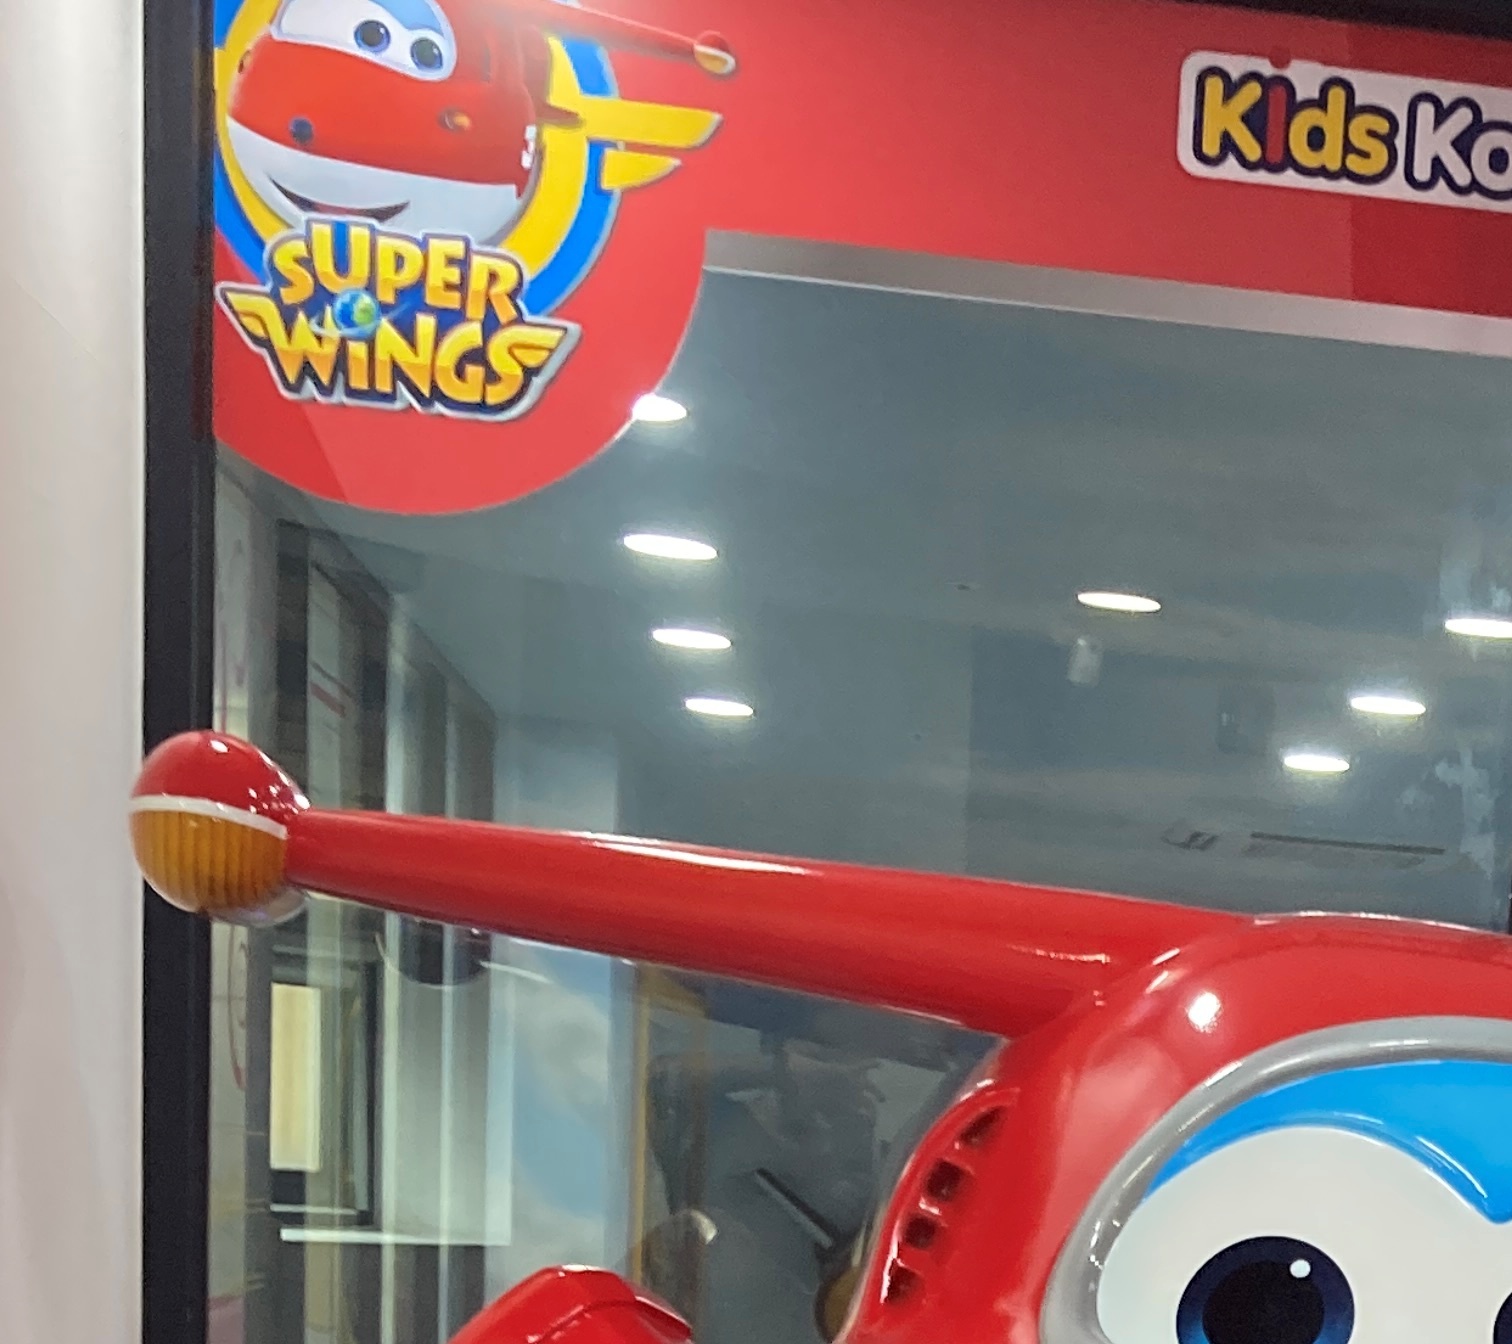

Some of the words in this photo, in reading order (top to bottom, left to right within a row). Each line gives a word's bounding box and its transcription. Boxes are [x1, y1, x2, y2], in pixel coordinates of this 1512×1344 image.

[1199, 74, 1392, 176] Kids
[269, 222, 524, 324] SUPER
[222, 290, 568, 407] WINGS
